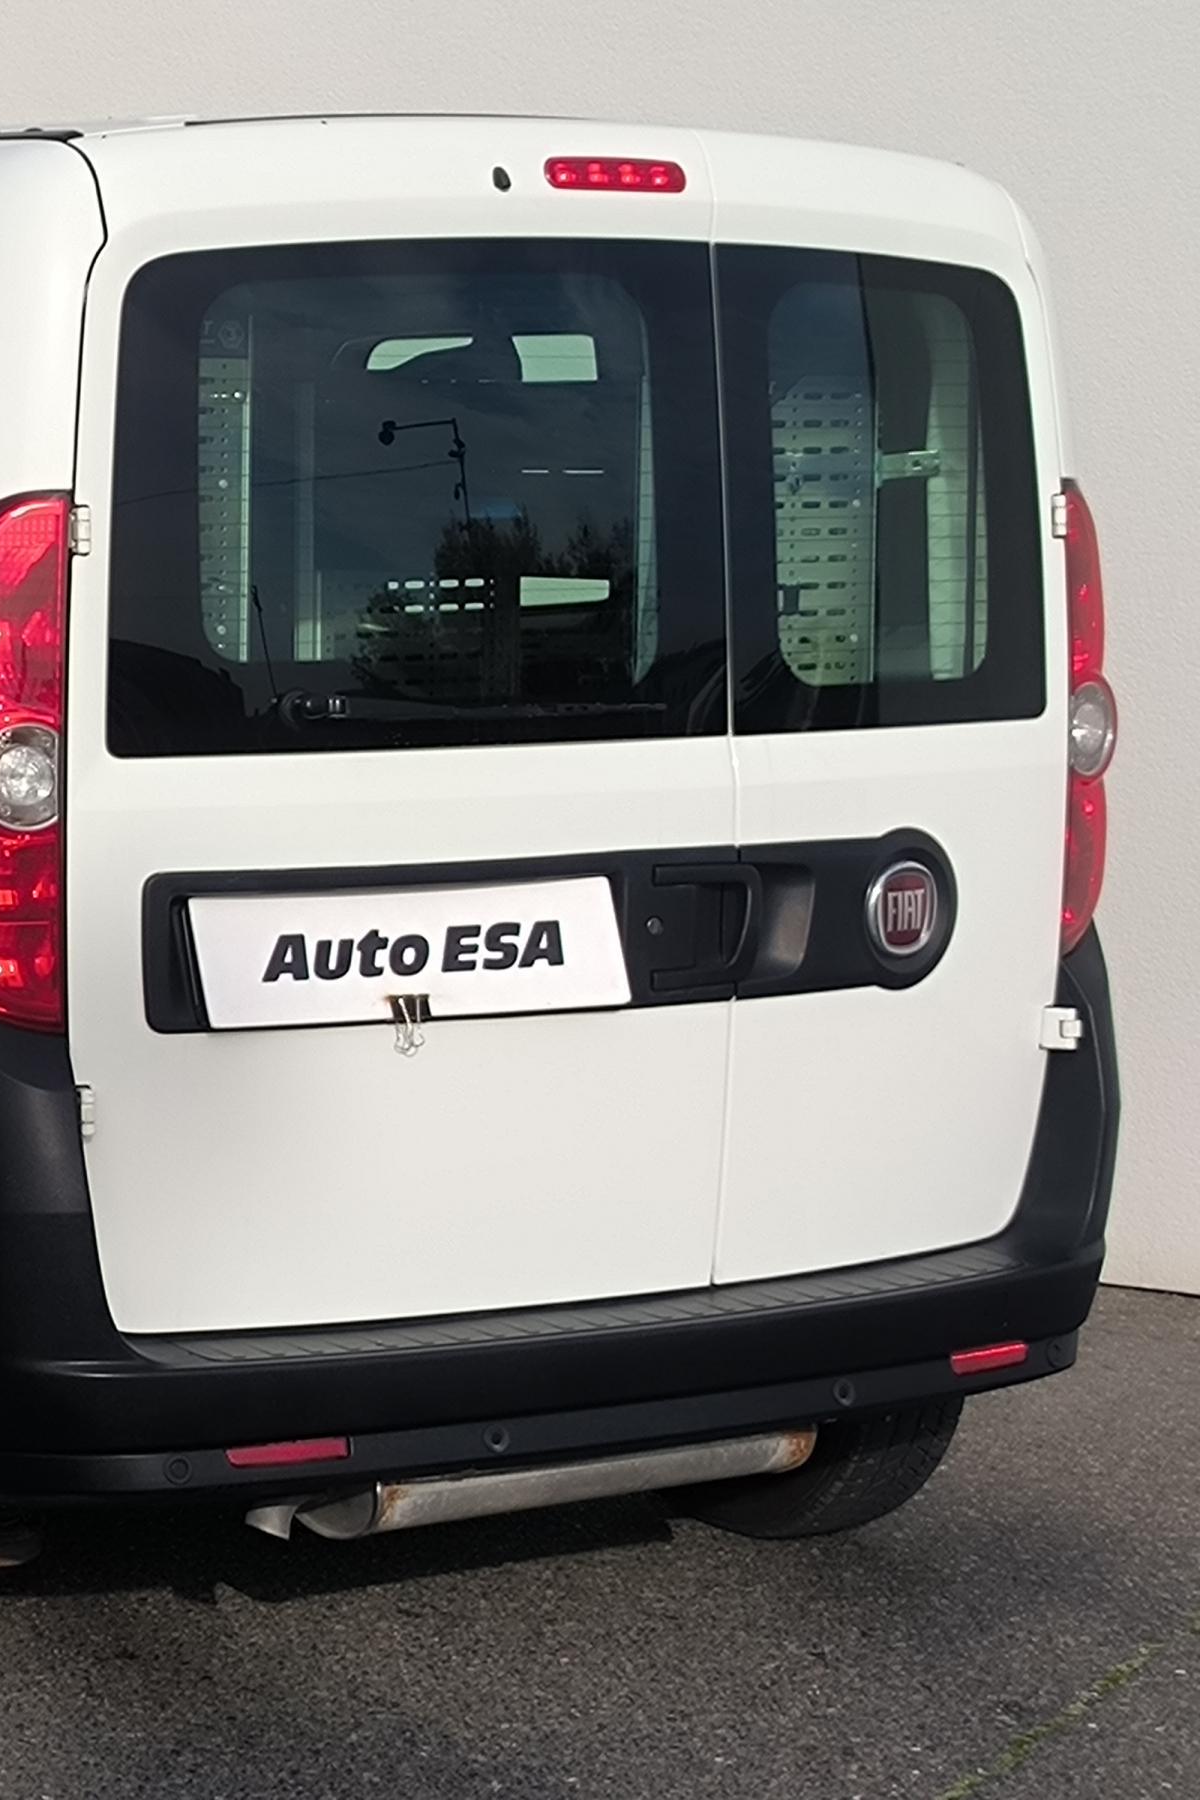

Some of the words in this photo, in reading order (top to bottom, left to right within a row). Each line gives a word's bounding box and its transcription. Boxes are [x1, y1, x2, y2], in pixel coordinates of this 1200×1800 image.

[886, 888, 925, 933] FIAT
[261, 929, 430, 983] Auto
[441, 920, 565, 973] ESA
